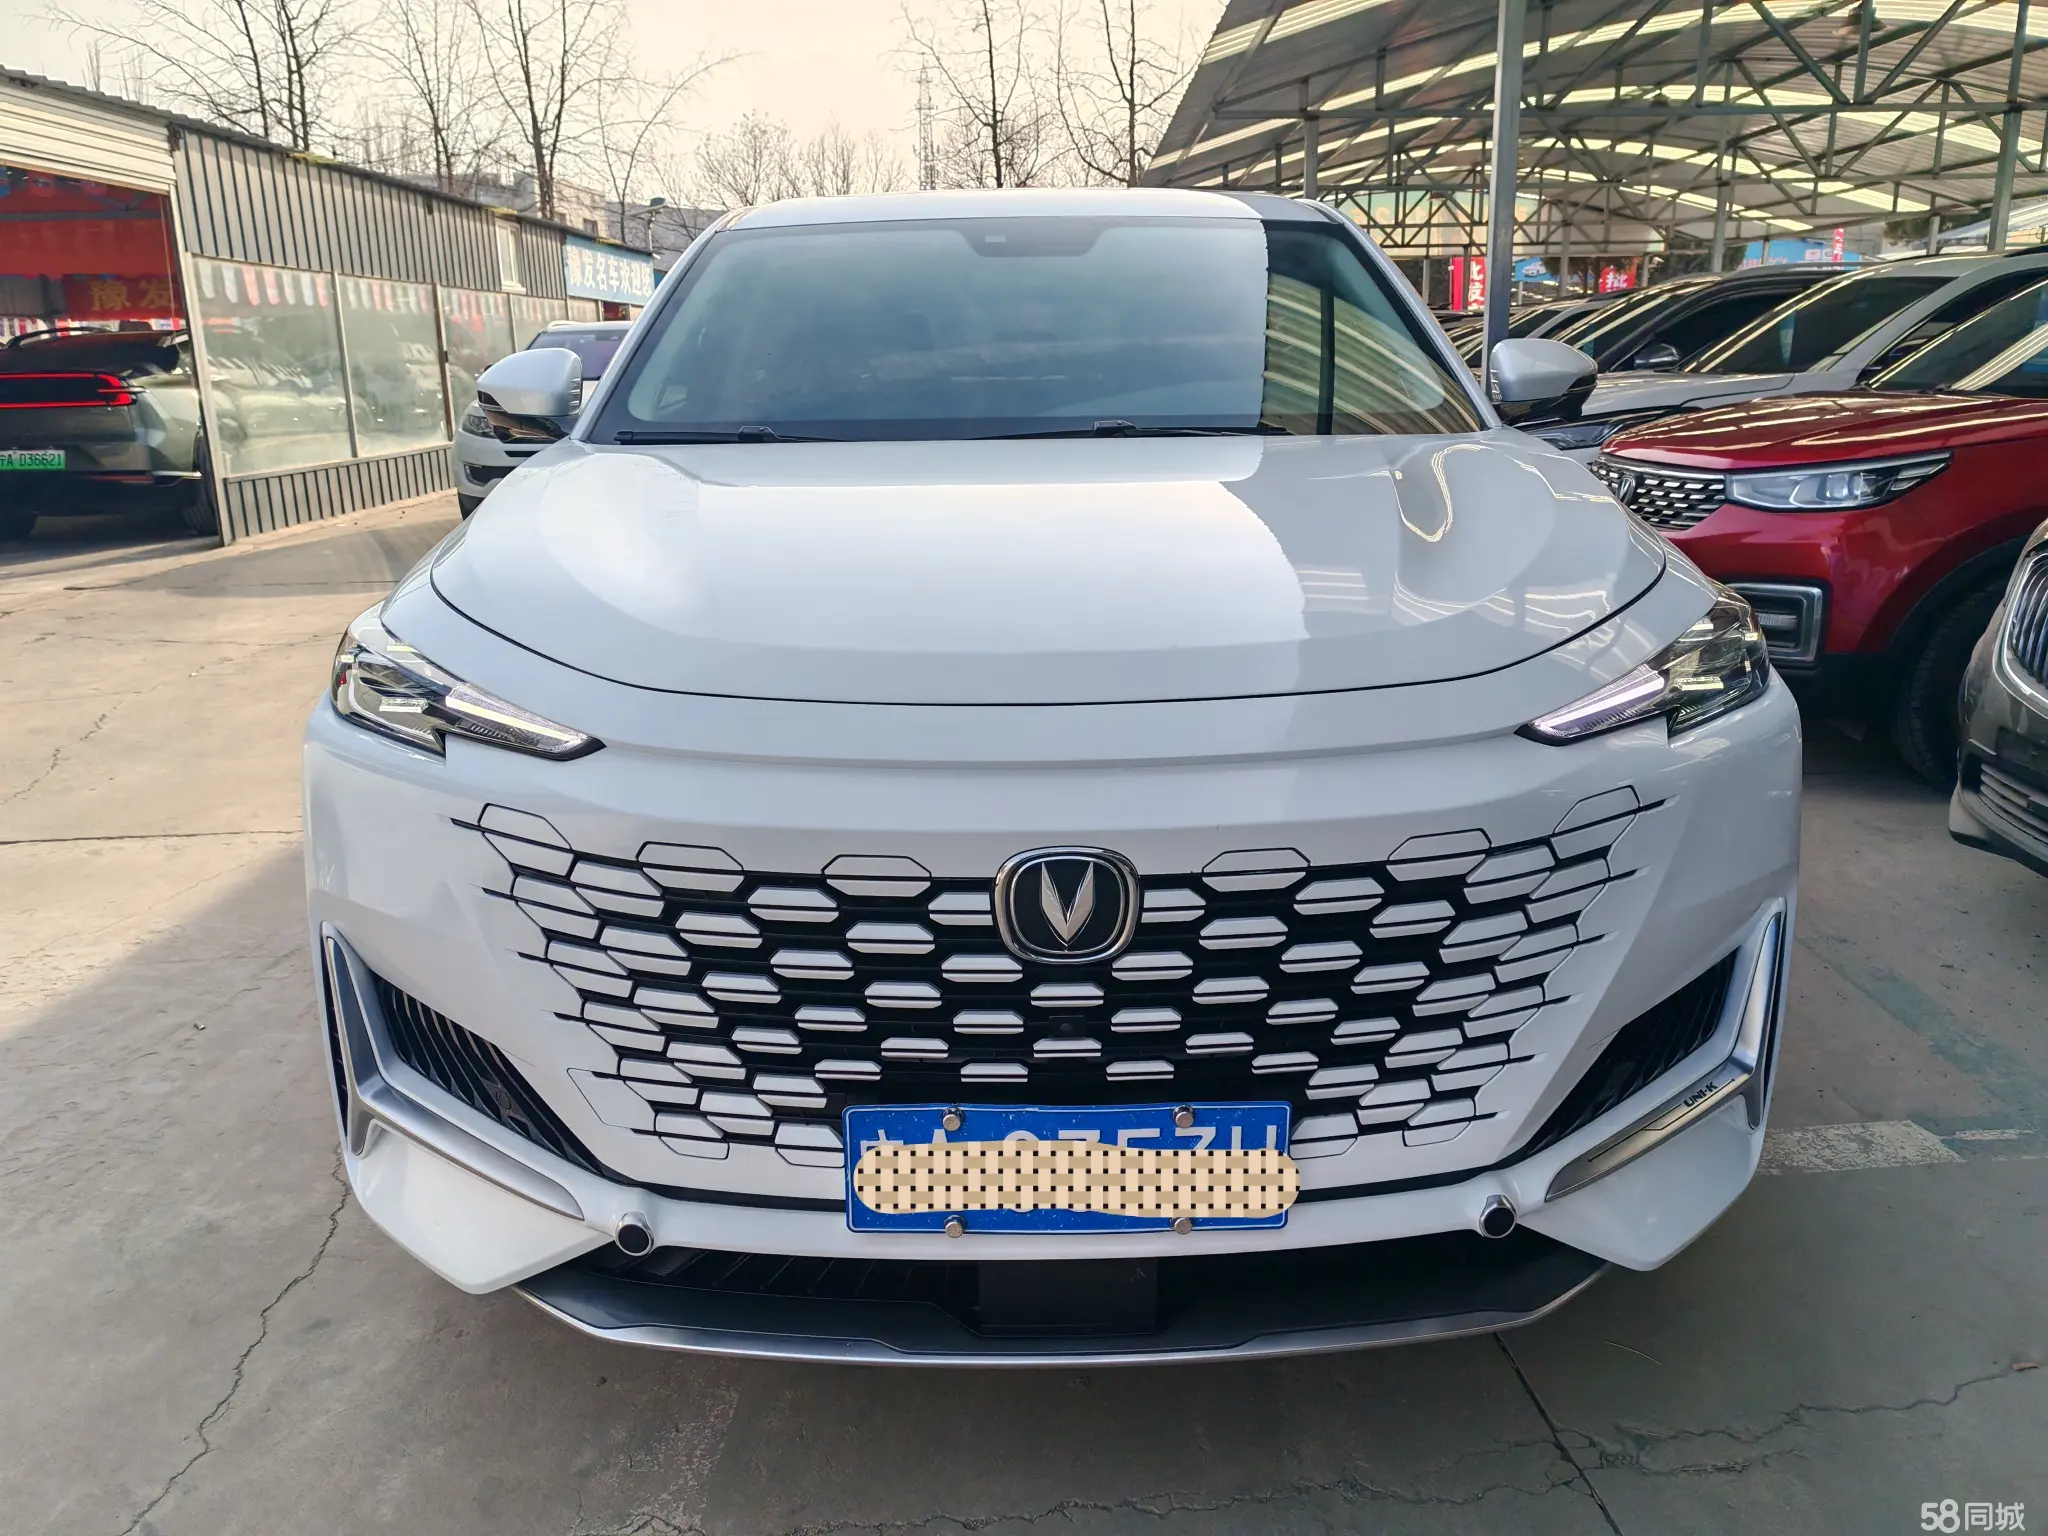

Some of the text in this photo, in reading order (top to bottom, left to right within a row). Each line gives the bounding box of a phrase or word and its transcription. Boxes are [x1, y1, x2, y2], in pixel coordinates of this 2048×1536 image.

[566, 244, 653, 298] 豫发名车欢迎您
[1683, 1081, 1719, 1108] UNI-K
